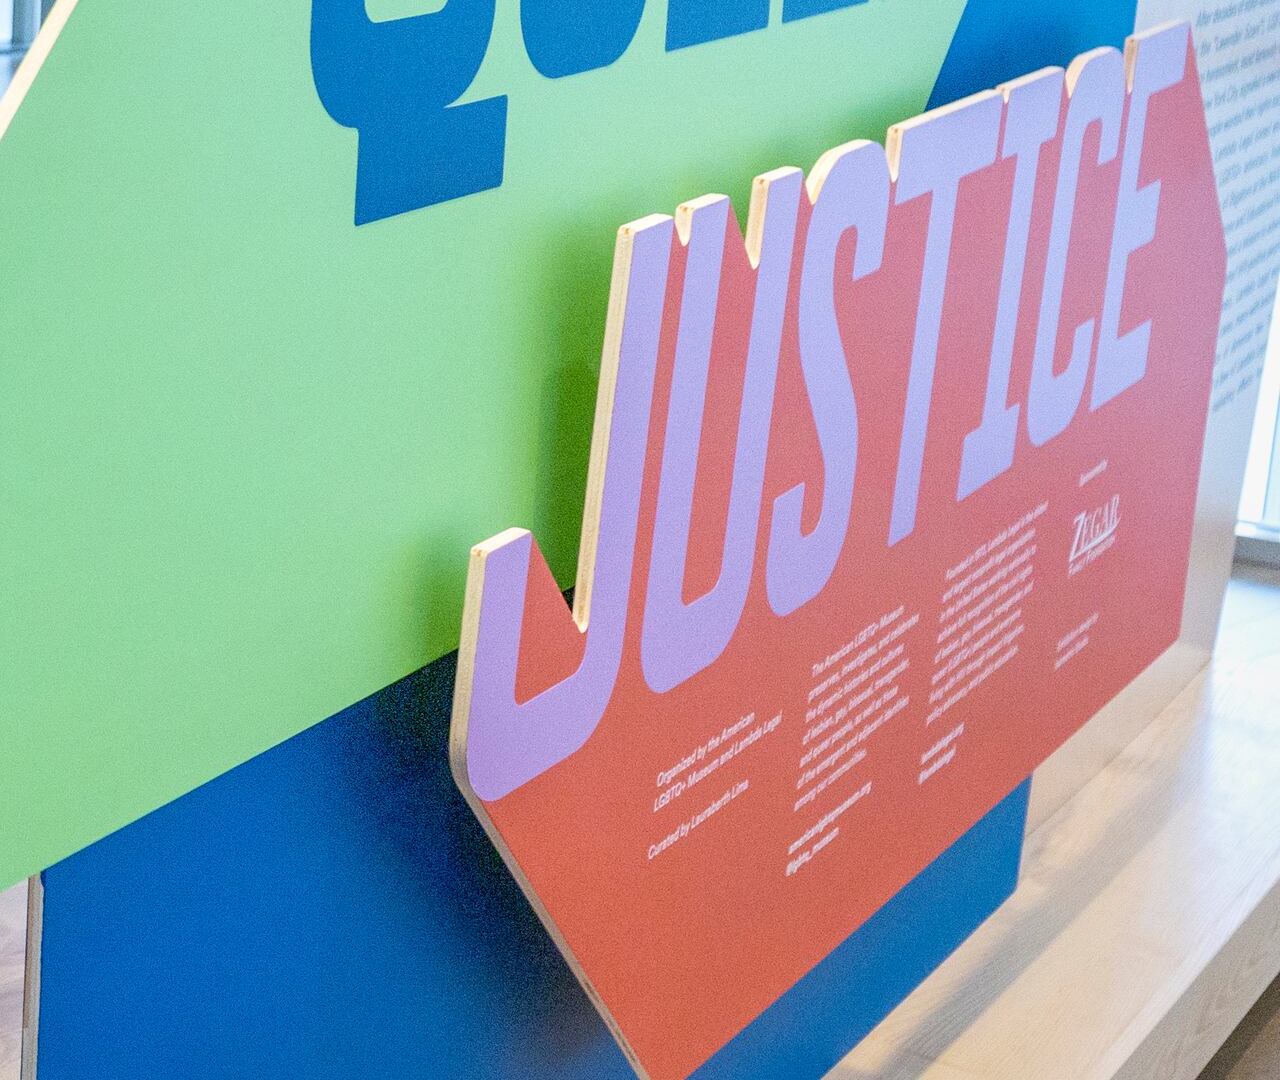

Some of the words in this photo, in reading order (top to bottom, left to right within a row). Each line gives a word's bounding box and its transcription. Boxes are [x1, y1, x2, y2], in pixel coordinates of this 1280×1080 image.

[467, 20, 1191, 802] JUSTICE
[656, 751, 697, 788] Organized
[720, 711, 756, 743] American
[647, 827, 681, 860] Curated
[730, 779, 750, 800] Lima
